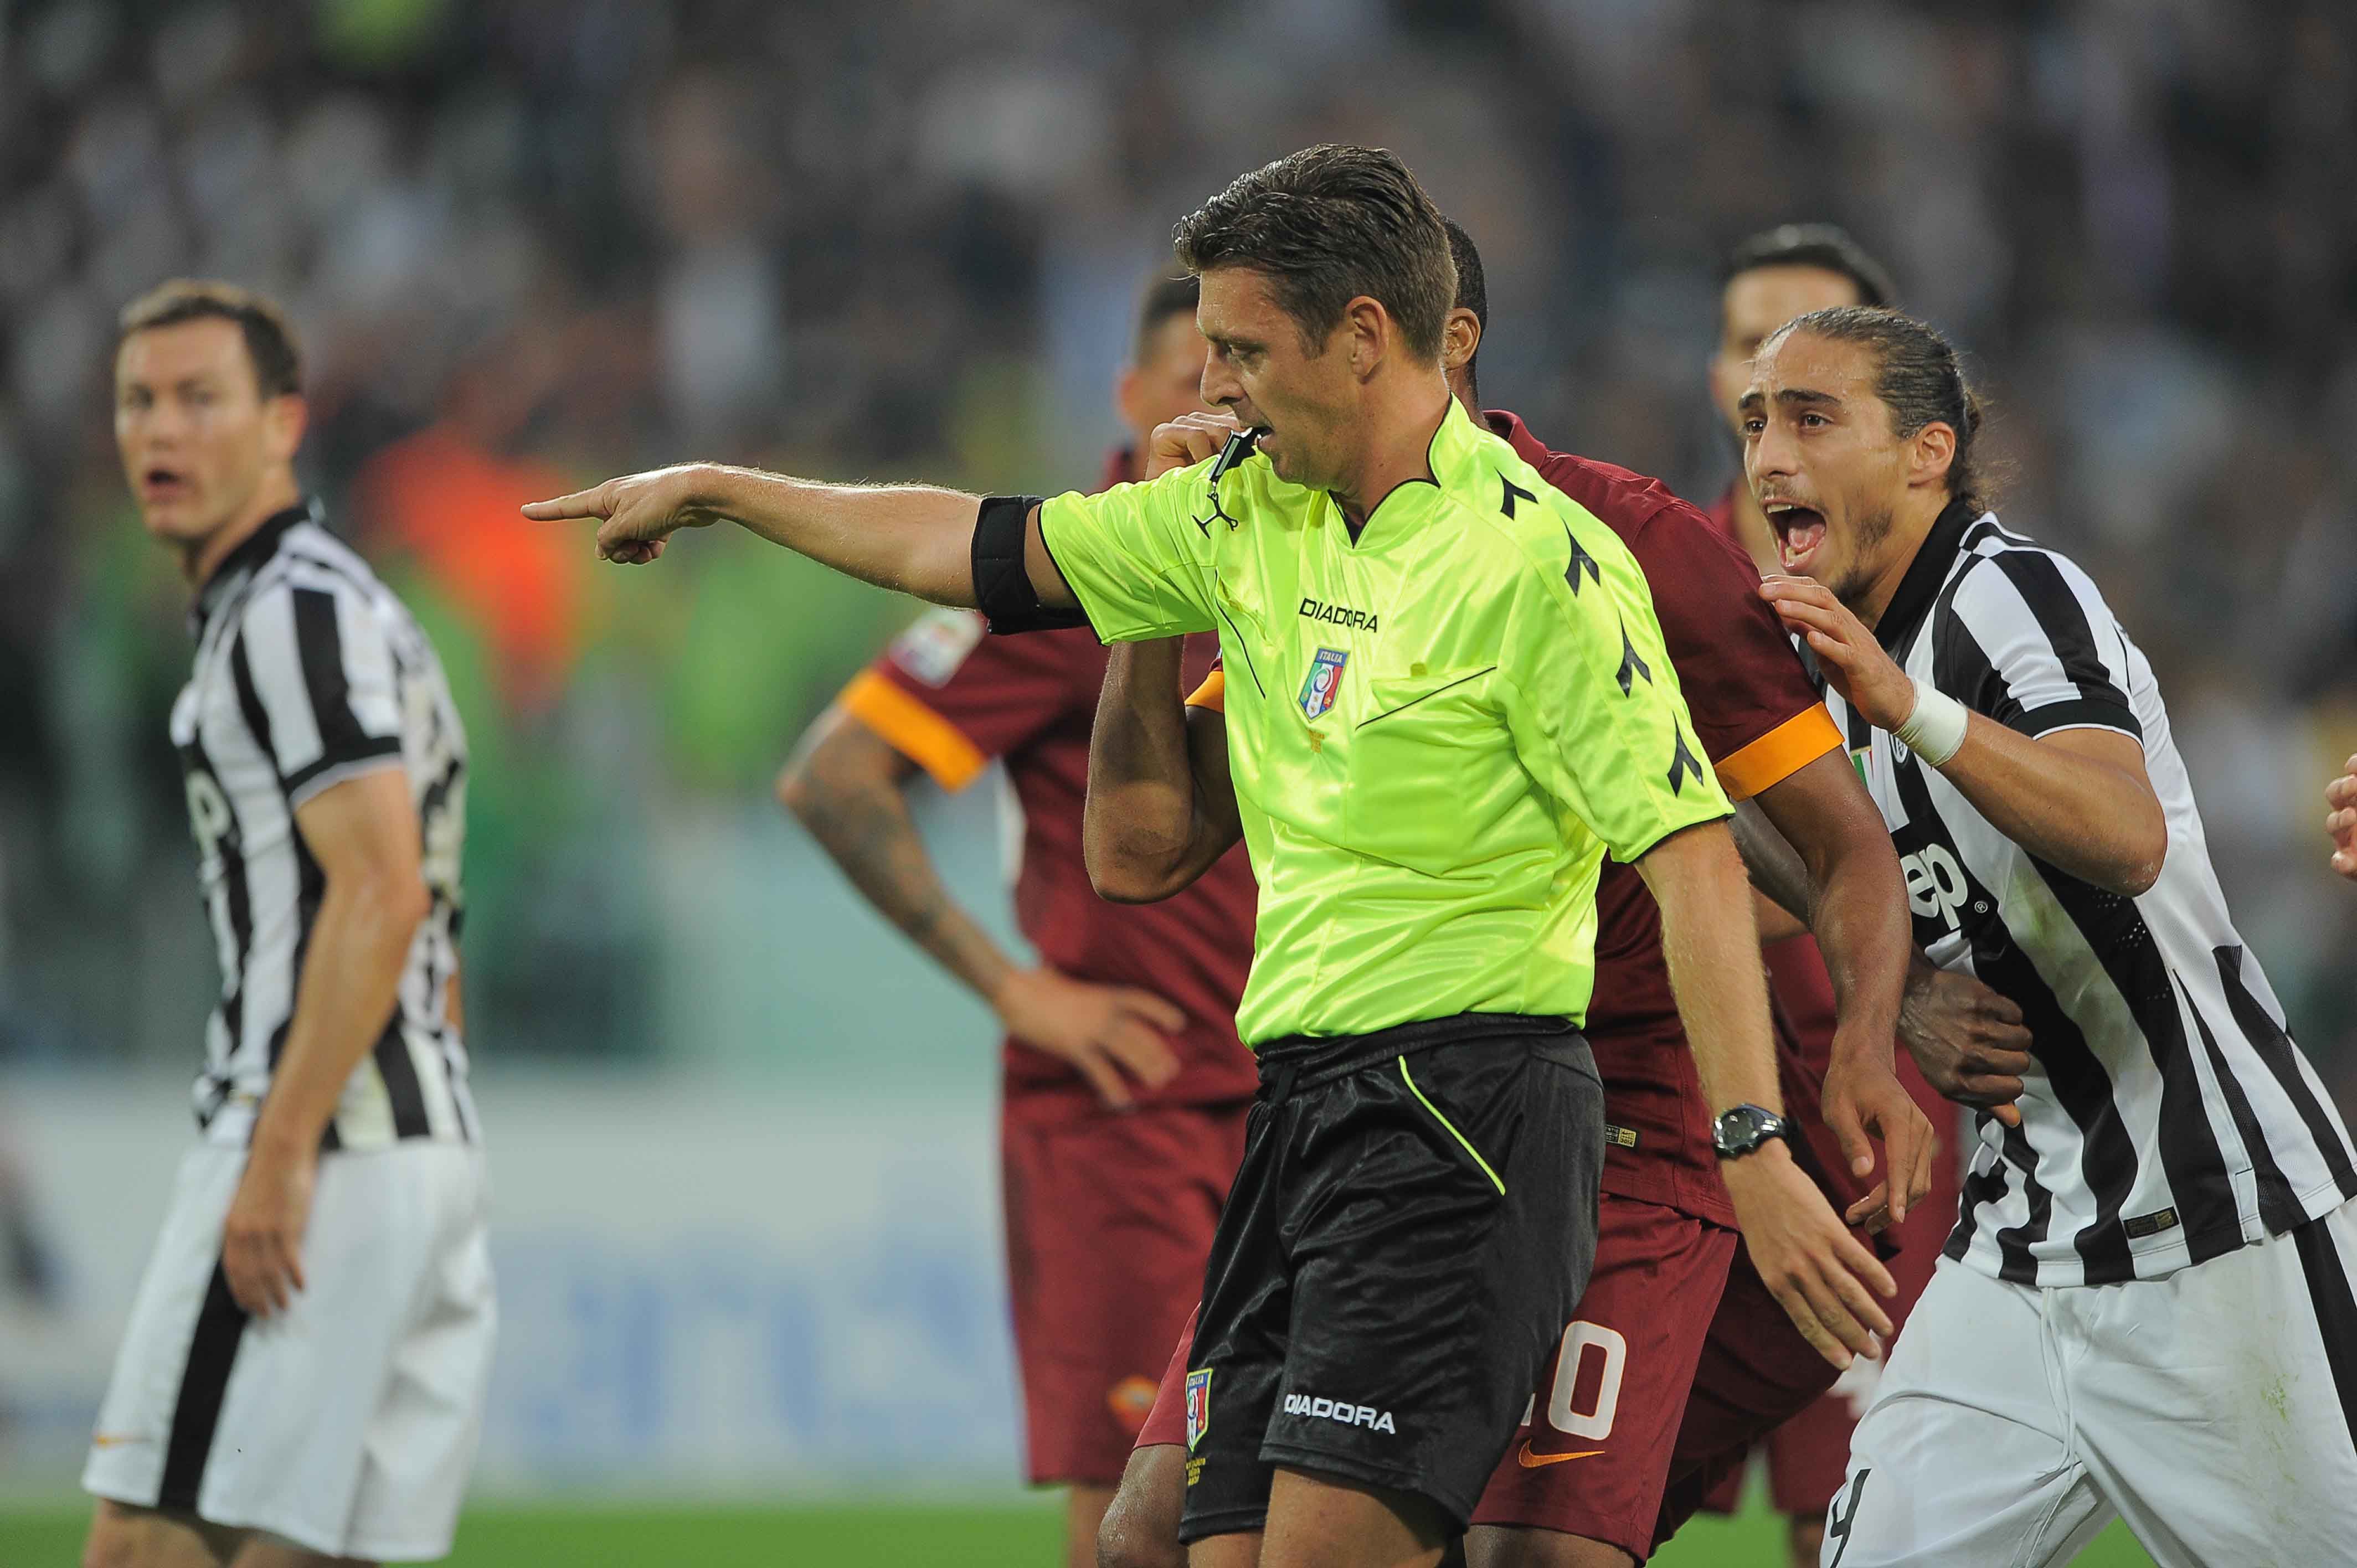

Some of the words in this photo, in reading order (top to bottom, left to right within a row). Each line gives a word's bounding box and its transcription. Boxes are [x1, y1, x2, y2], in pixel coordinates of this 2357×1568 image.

[1298, 598, 1378, 633] DIADORA
[1319, 651, 1343, 664] ITALIA
[1188, 1374, 1204, 1388] ITALIA
[1520, 1320, 1627, 1441] 0
[1284, 1393, 1396, 1435] DIADORA
[1830, 1468, 1872, 1568] 4
